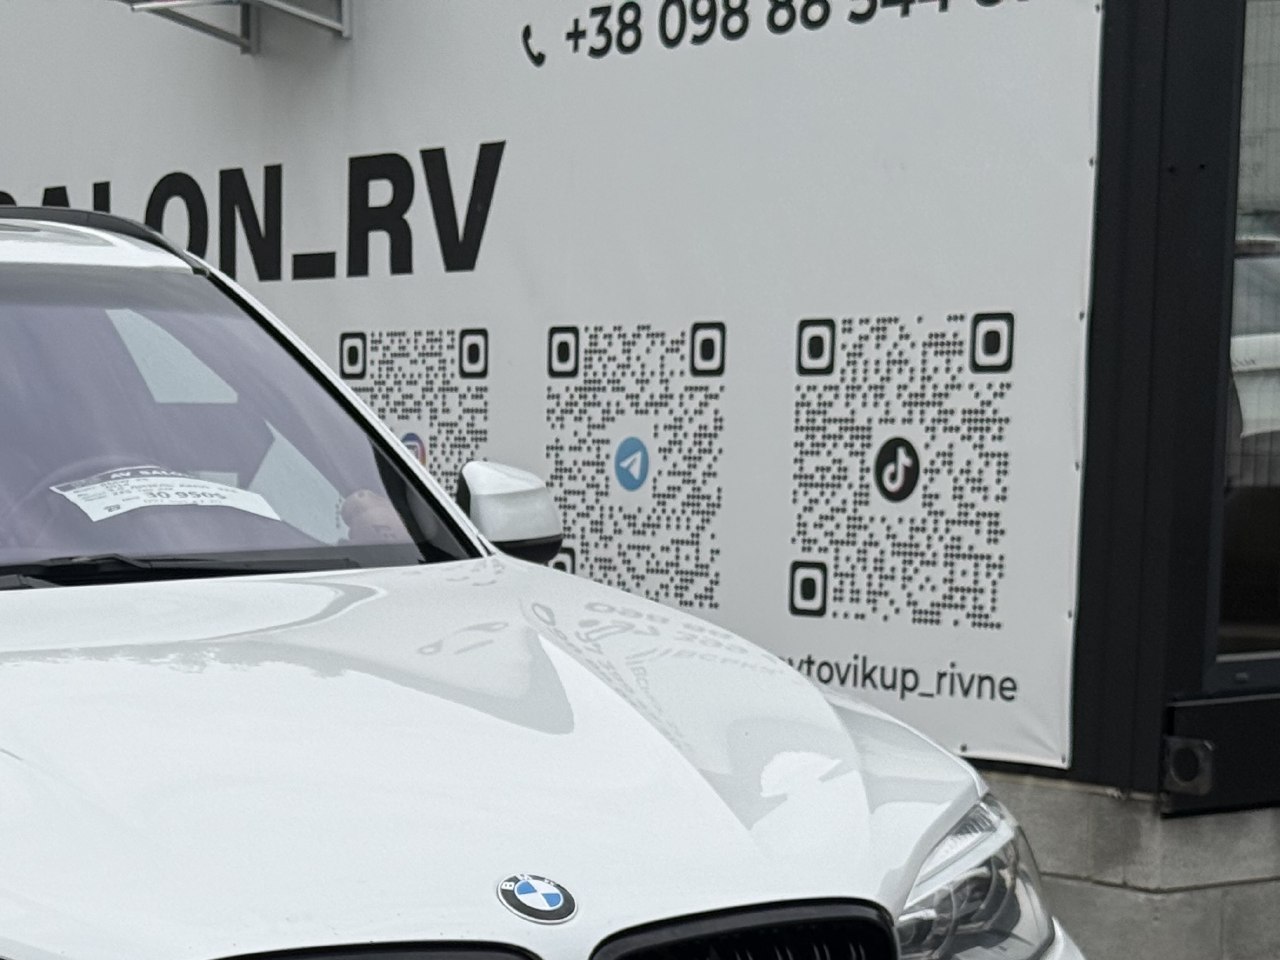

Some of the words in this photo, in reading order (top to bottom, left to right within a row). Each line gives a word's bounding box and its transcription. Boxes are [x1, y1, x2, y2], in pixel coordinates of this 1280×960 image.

[565, 1, 642, 59] +38
[658, 0, 750, 49] 098
[779, 653, 1018, 701] vtovikup_rivne
